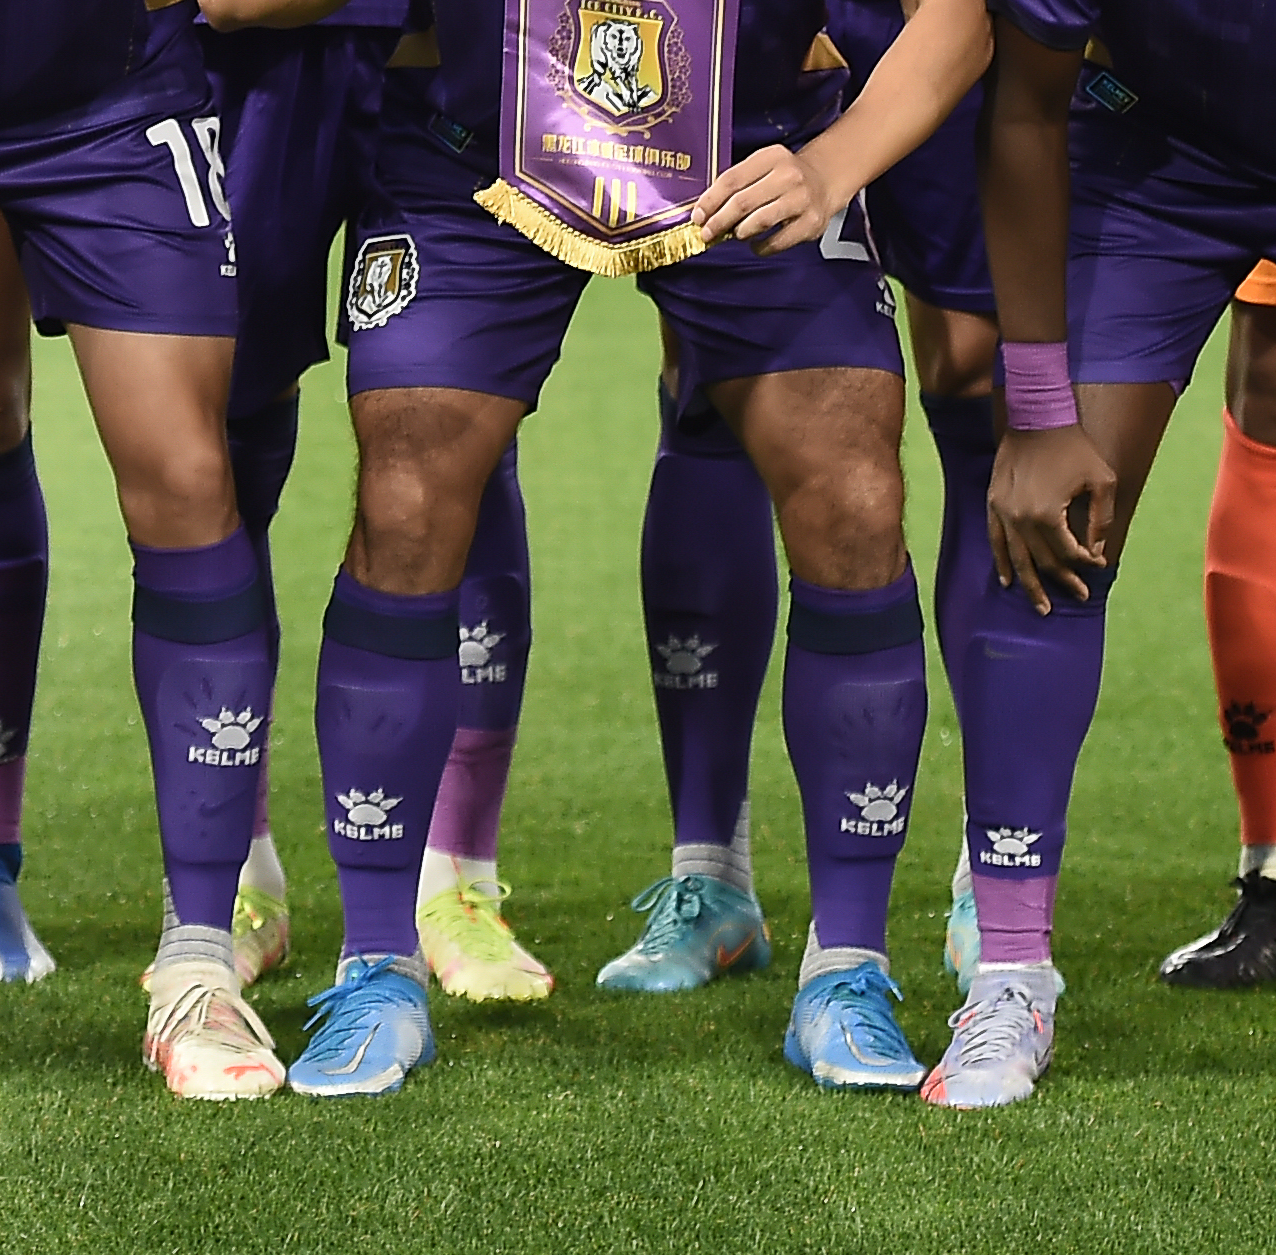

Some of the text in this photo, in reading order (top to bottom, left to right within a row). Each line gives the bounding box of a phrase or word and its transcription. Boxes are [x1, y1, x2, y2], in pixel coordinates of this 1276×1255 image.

[461, 665, 506, 685] LME
[188, 746, 260, 766] KELME
[334, 818, 404, 841] KELME
[840, 817, 904, 837] KELME
[980, 851, 1042, 867] KELME
